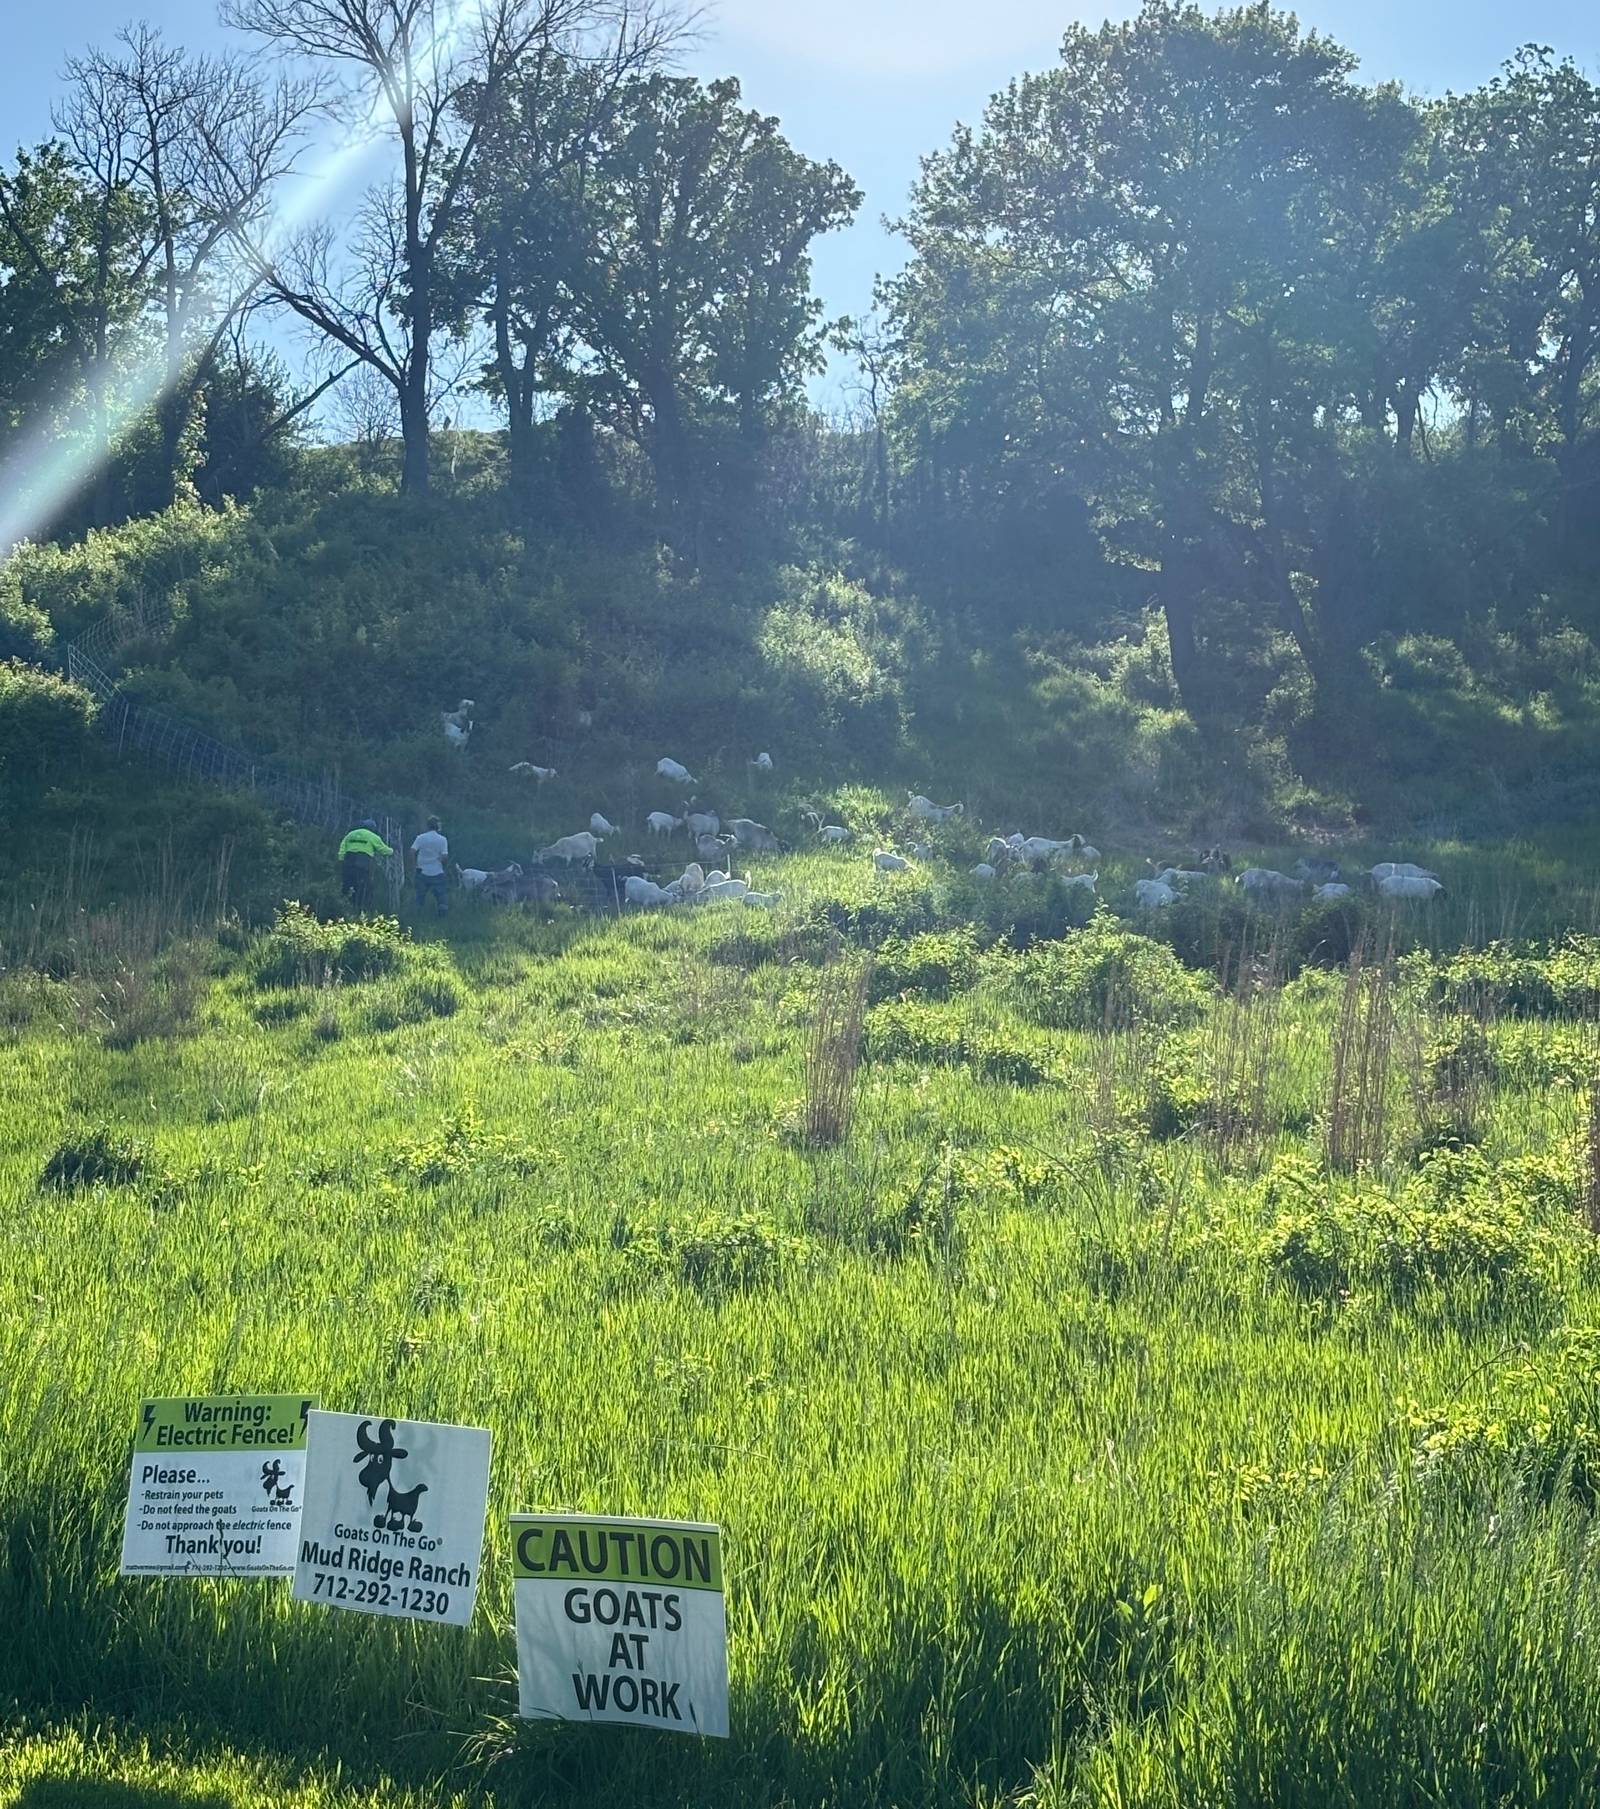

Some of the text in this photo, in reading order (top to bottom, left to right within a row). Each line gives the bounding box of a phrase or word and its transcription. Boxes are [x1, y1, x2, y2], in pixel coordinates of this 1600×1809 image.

[184, 1400, 272, 1426] Warning:
[156, 1422, 295, 1446] Electric Fence!
[142, 1465, 210, 1484] Please...
[182, 1491, 201, 1501] your
[204, 1490, 224, 1501] pets
[157, 1505, 172, 1514] not
[173, 1504, 193, 1514] feed
[195, 1504, 210, 1514] the
[212, 1505, 237, 1516] goats
[155, 1521, 170, 1530] not
[172, 1520, 214, 1532] approach
[232, 1519, 265, 1530] electric
[266, 1520, 292, 1530] fence
[334, 1523, 369, 1542] Goats
[372, 1529, 389, 1545] On
[392, 1531, 415, 1549] The
[165, 1534, 262, 1558] Thank you!
[517, 1528, 712, 1584] CAUTION
[300, 1540, 471, 1588] Mud Ridge Ranch
[312, 1572, 450, 1615] 712-292-1230
[564, 1587, 682, 1632] GOATS
[608, 1632, 649, 1671] AT
[572, 1673, 683, 1721] WORK
